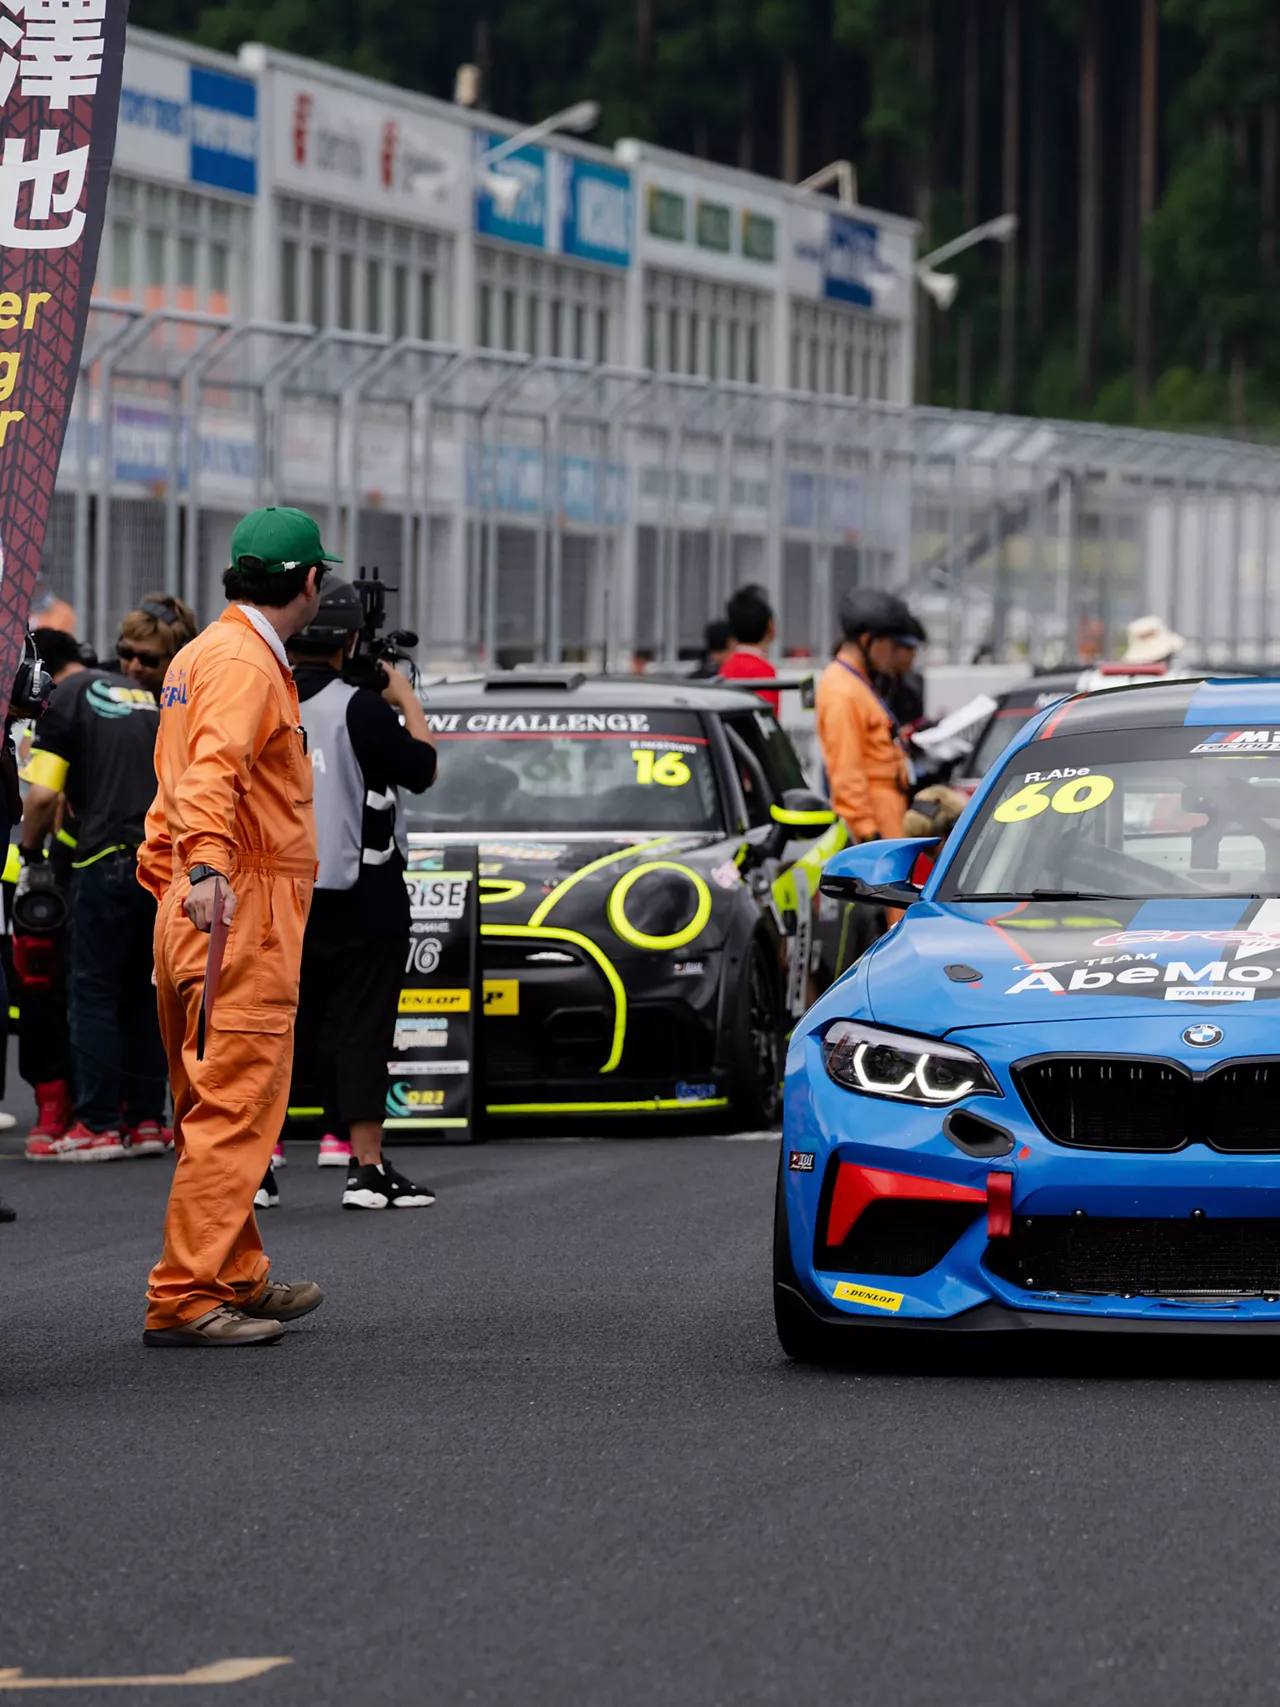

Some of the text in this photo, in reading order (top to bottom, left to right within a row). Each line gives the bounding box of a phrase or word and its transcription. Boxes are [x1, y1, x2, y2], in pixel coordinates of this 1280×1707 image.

[466, 713, 650, 732] CHALLENGE
[632, 749, 692, 787] 16
[1024, 767, 1091, 784] R.Abe
[993, 775, 1115, 823] 60
[405, 938, 442, 974] 16
[1084, 952, 1158, 967] TEAM
[402, 996, 460, 1004] UNLOP
[1175, 989, 1246, 998] TAMRON
[849, 1288, 896, 1304] DUNLOP
